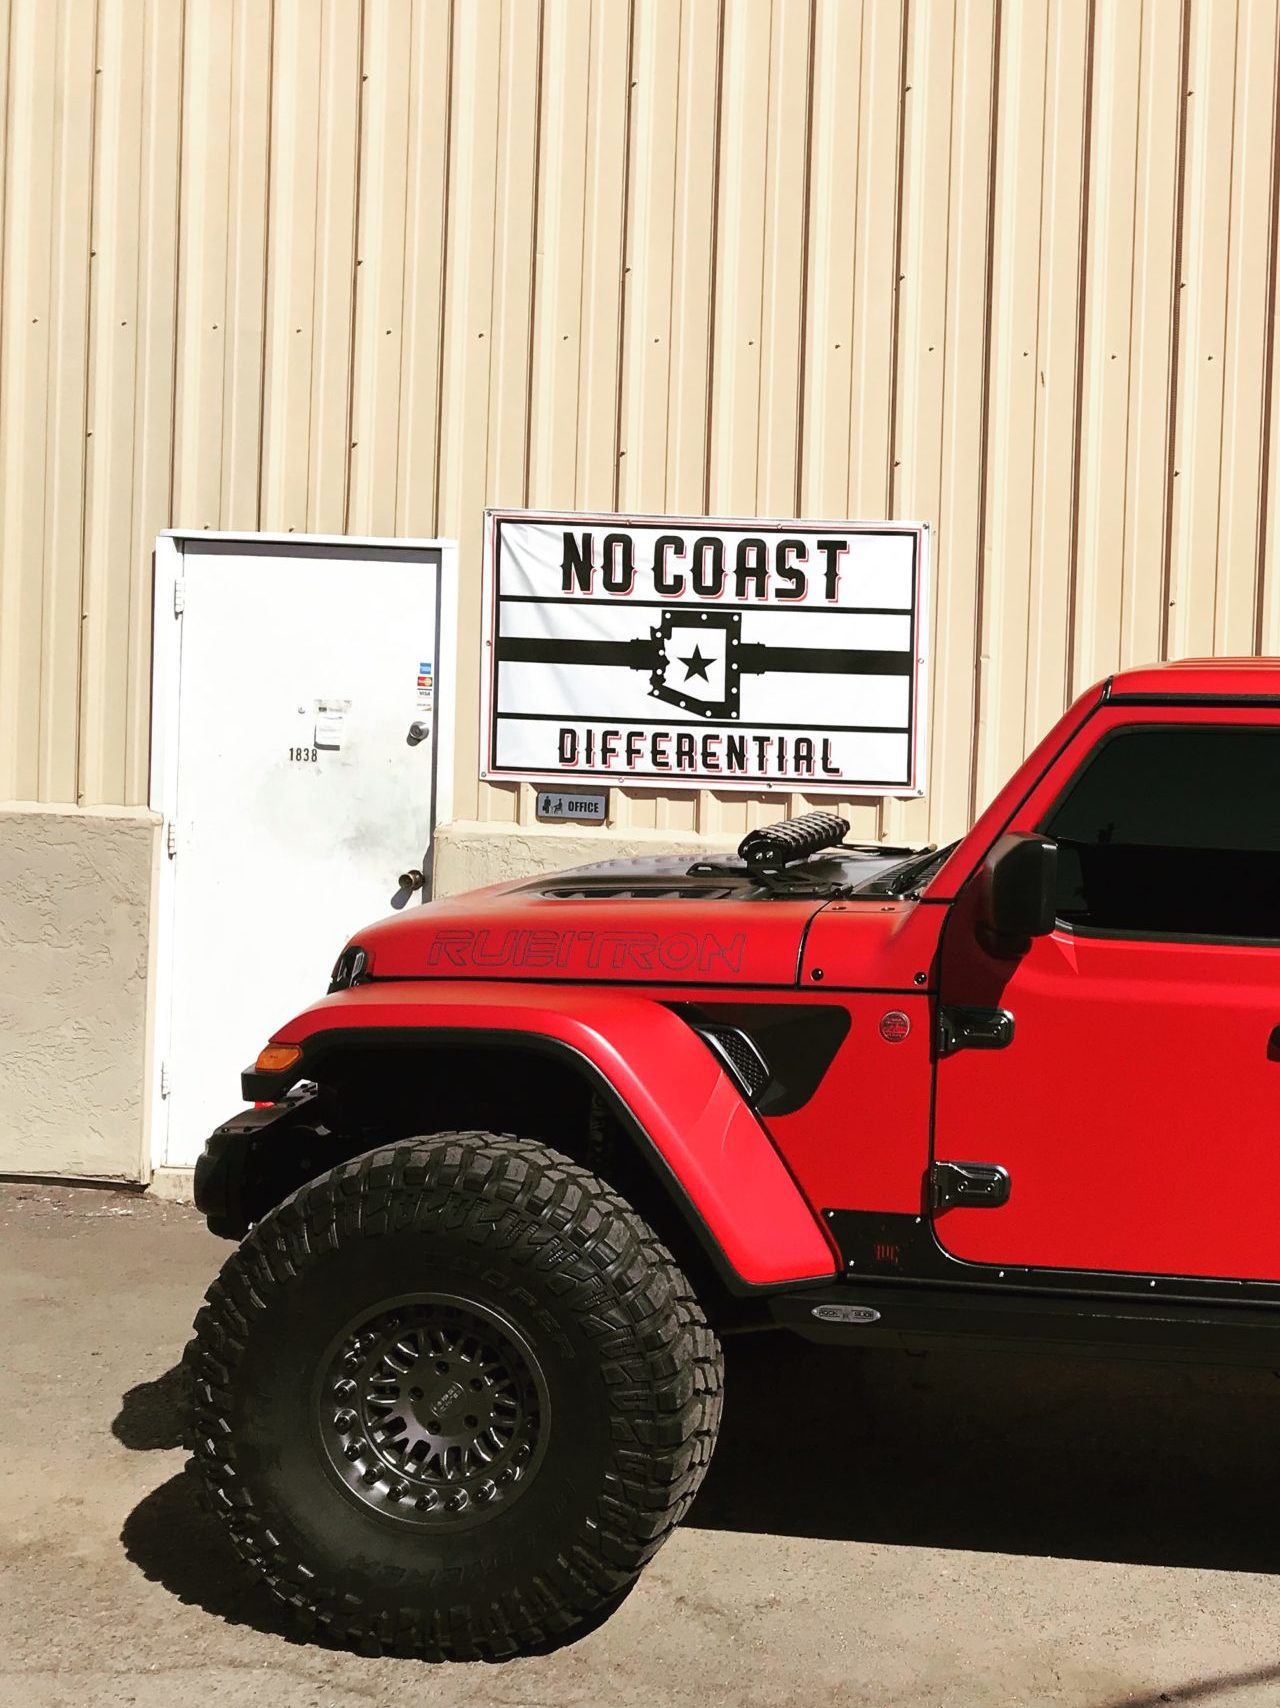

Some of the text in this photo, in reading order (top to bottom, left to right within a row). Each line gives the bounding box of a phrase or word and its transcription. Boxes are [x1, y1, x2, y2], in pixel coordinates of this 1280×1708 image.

[559, 532, 850, 603] NO COAST
[289, 747, 318, 762] 1838
[558, 727, 843, 776] DIFFERENTIAL
[568, 801, 599, 813] OFFICE
[427, 929, 746, 973] RUBITRON
